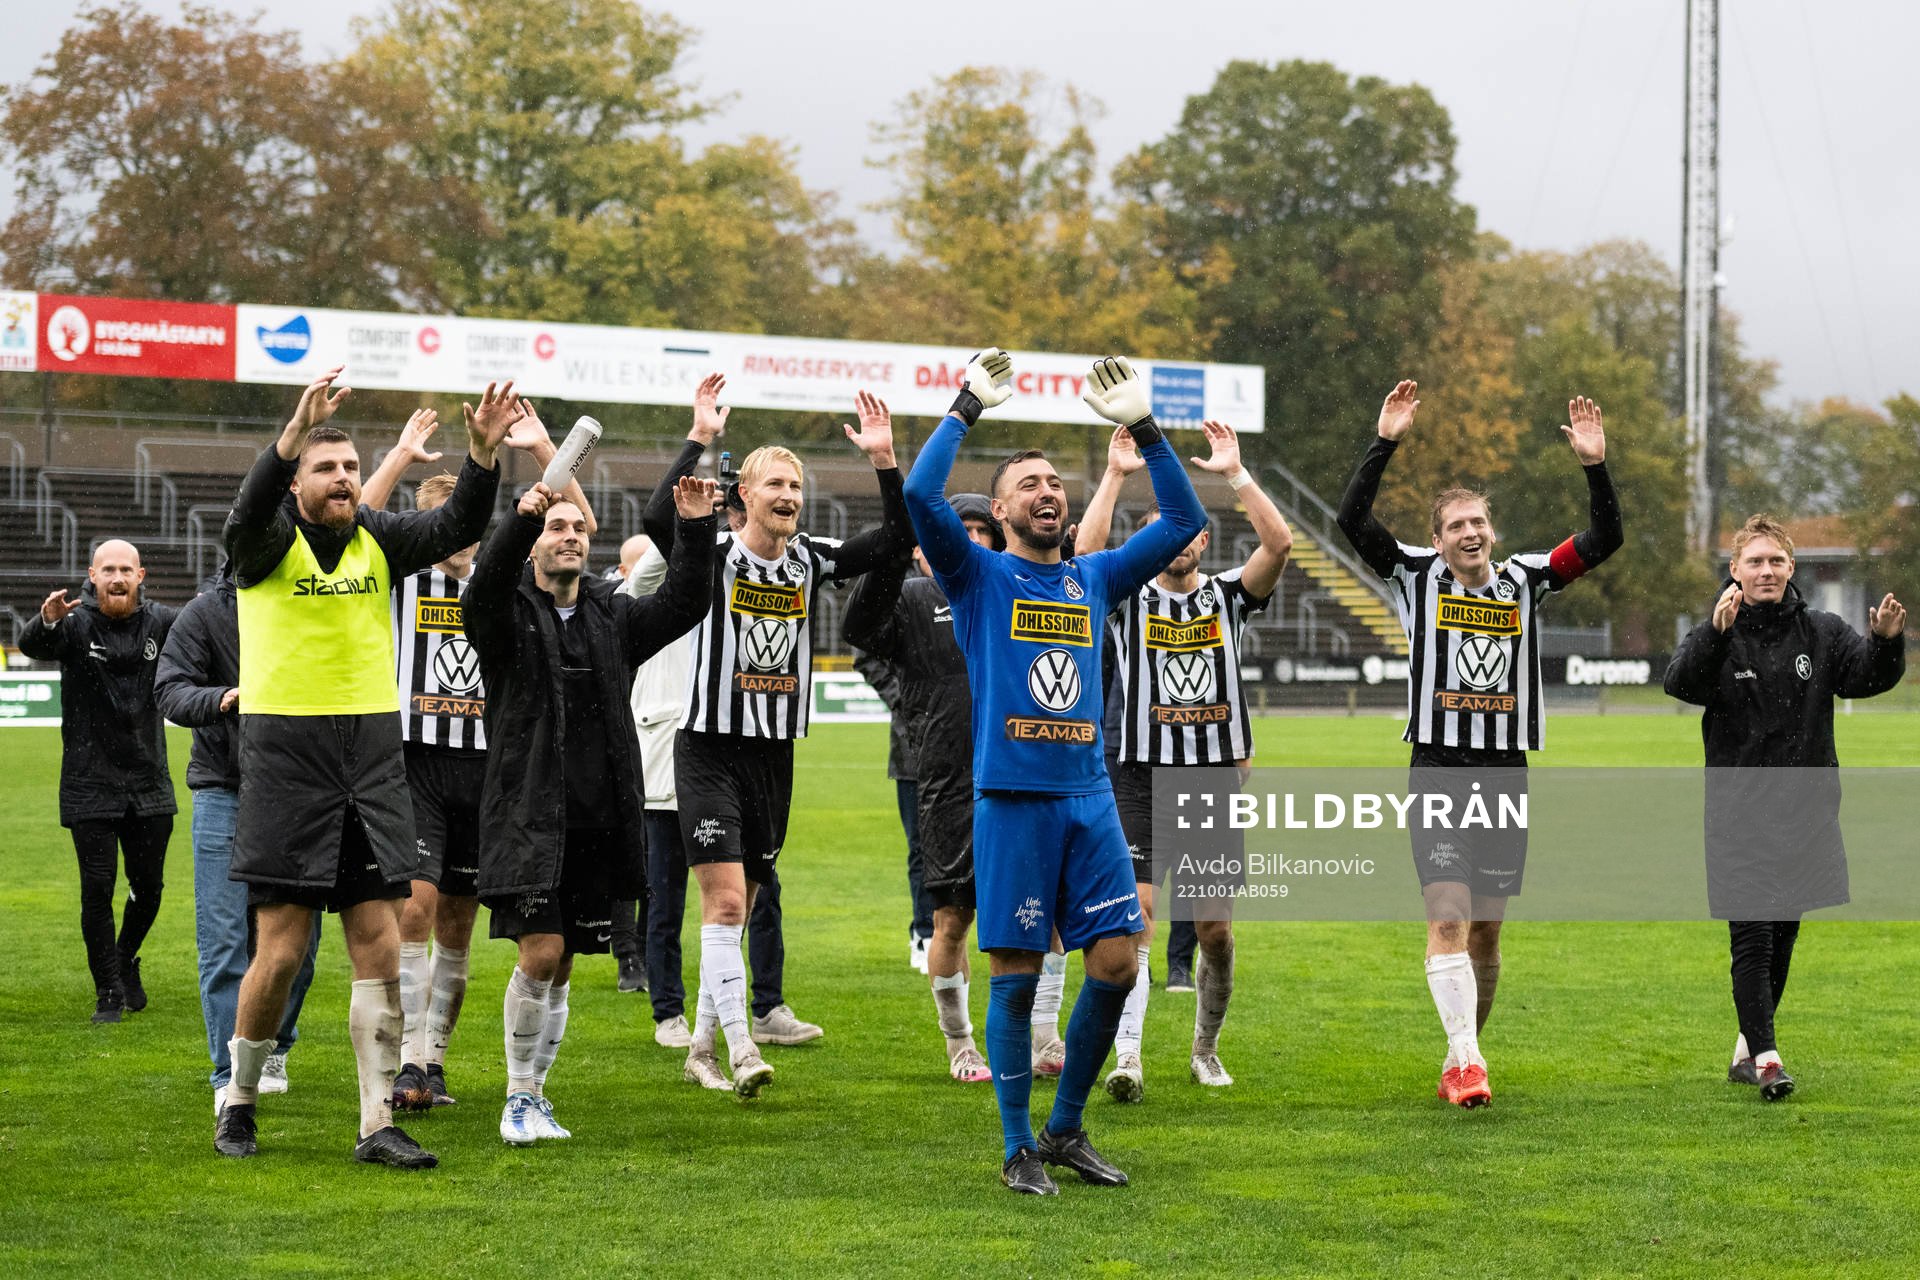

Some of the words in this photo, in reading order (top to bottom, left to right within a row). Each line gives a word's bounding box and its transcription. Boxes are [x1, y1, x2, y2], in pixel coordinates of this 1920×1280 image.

[743, 353, 895, 383] RINGSERVICE
[1016, 372, 1086, 396] CITY
[568, 433, 599, 475] SERNEKE
[735, 588, 793, 611] OHLSSON
[421, 607, 463, 624] OHLSS
[1017, 611, 1085, 635] OHLSSONS
[1441, 604, 1510, 627] OHLSSONS
[1149, 624, 1209, 642] OHLSSONS
[1566, 654, 1651, 685] Derome
[411, 695, 485, 718] TEAMA
[1434, 691, 1517, 712] TEAMAB
[1150, 704, 1230, 723] TEAMAB
[1006, 718, 1095, 743] TEAMAB
